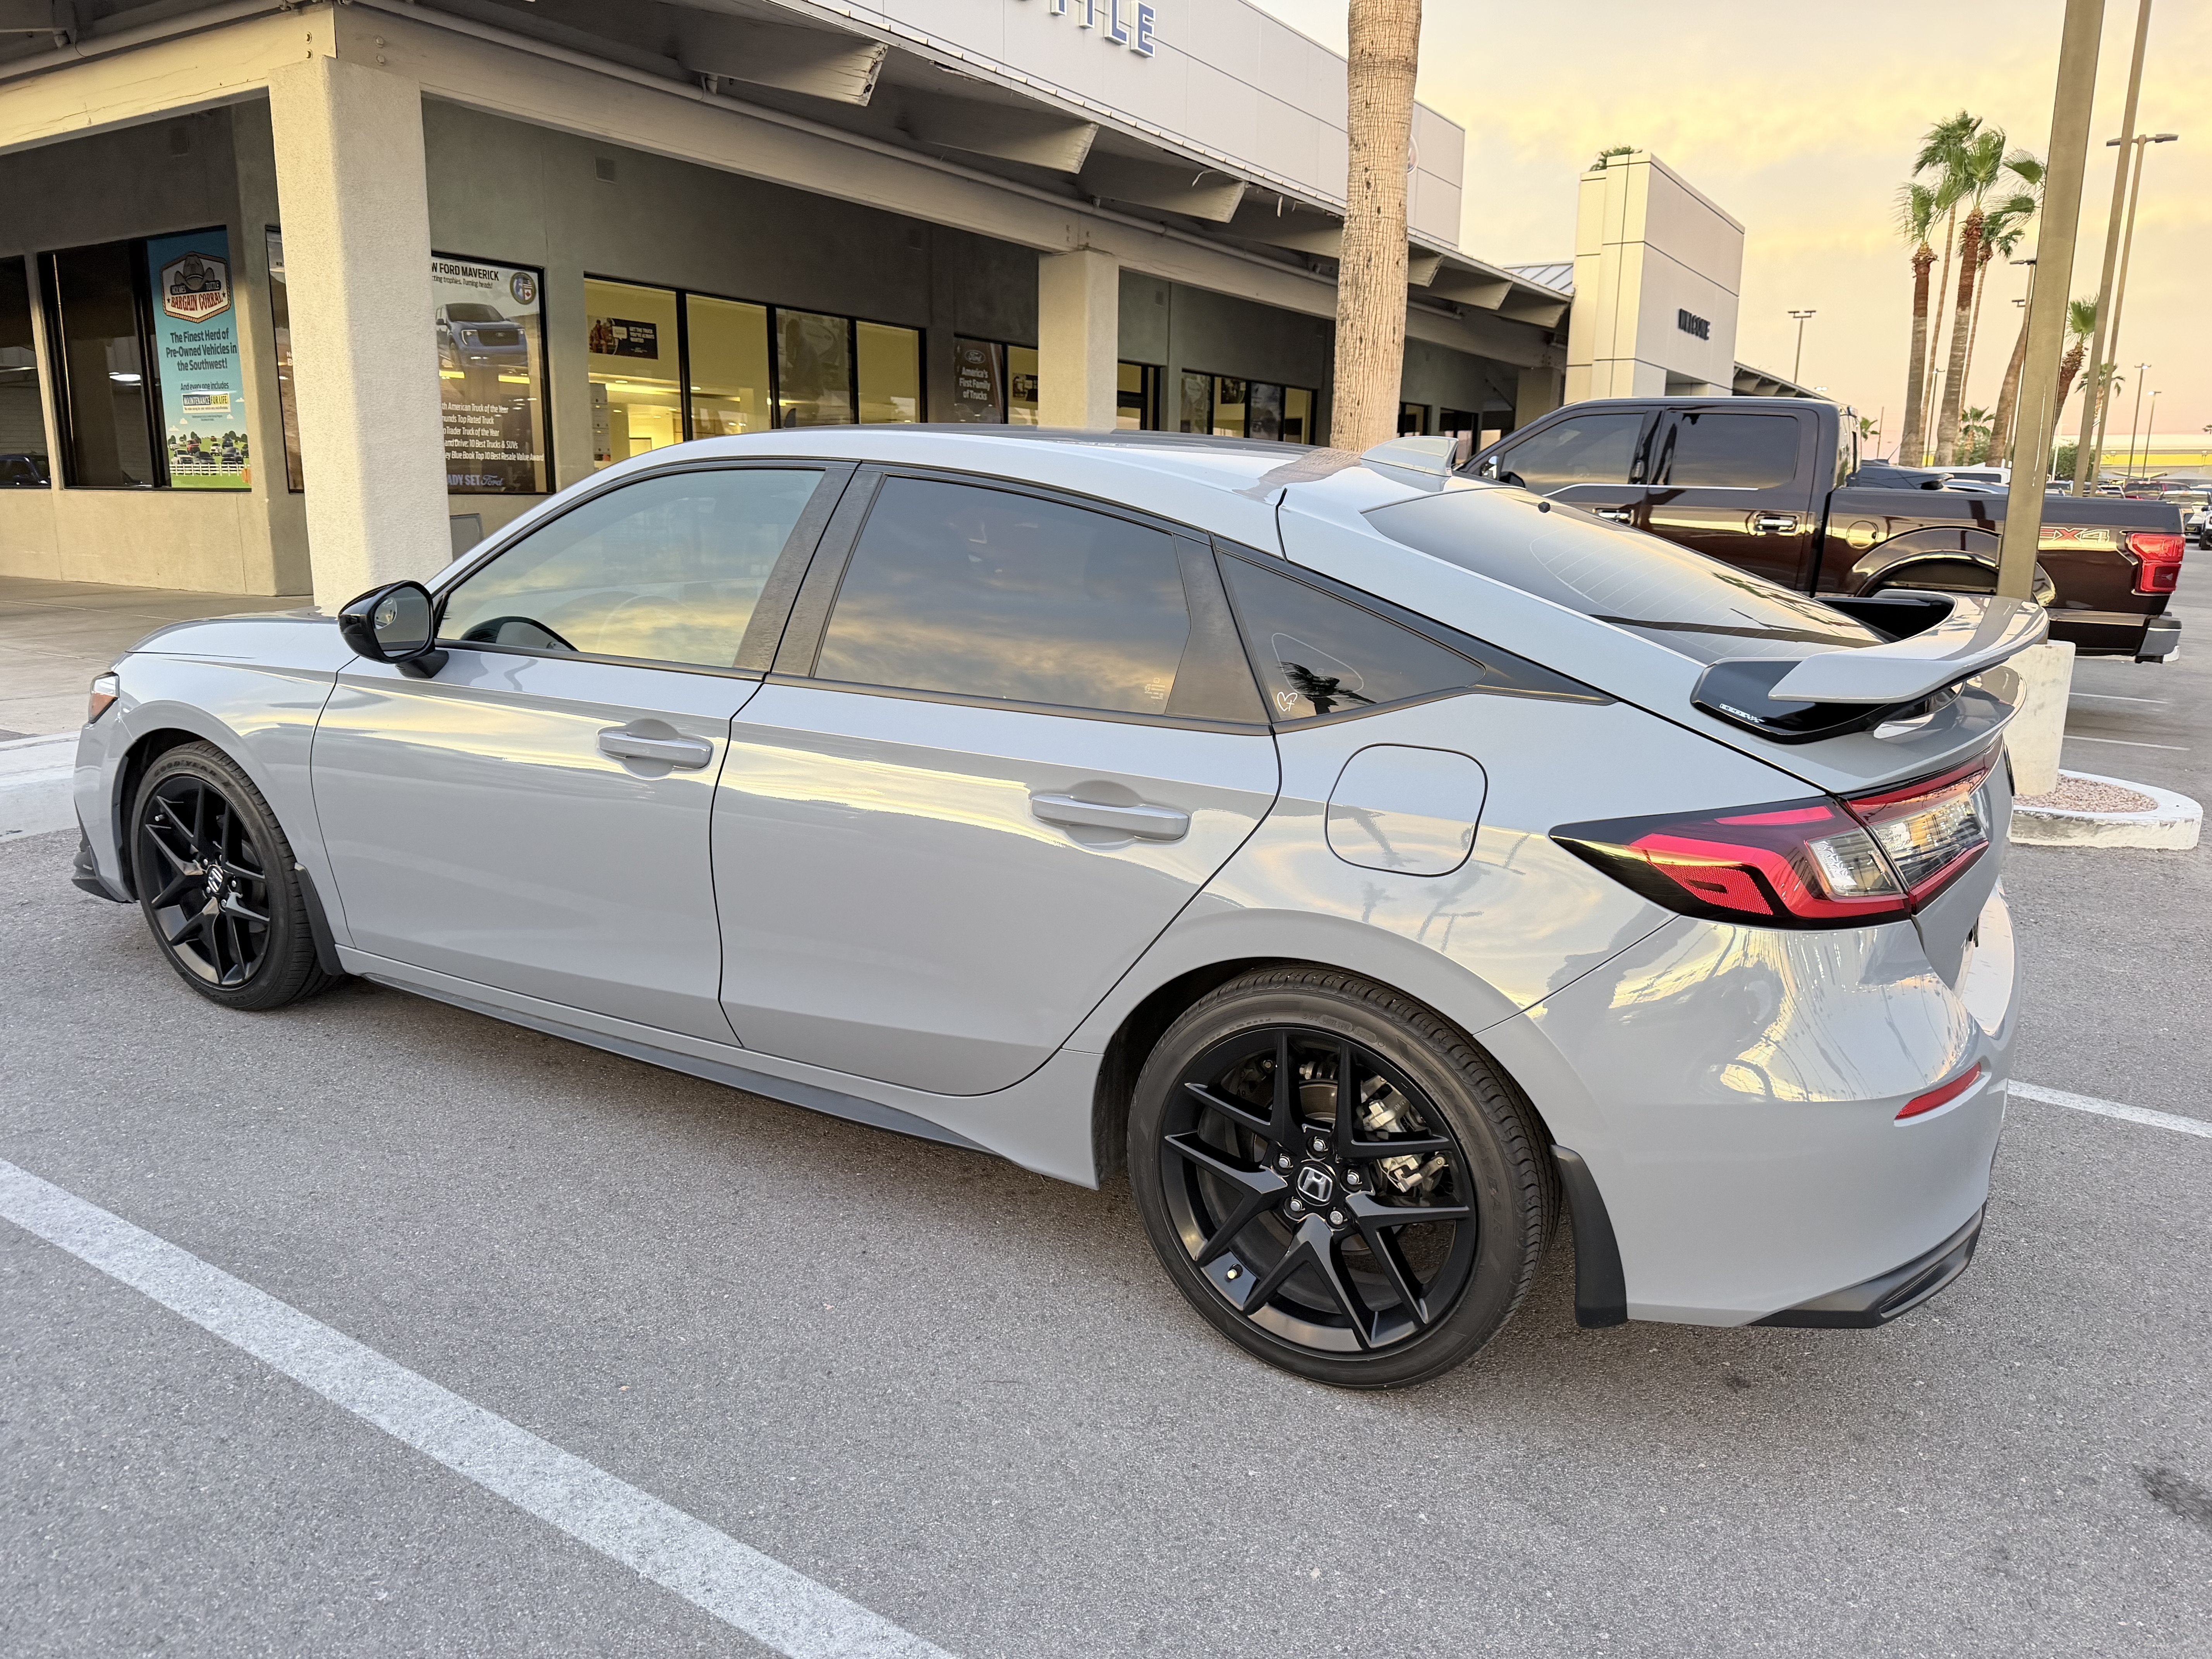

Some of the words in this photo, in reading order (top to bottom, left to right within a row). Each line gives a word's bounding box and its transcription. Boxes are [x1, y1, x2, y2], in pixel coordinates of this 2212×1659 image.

[440, 263, 460, 275] FORD
[462, 266, 499, 281] MAVERICK
[172, 285, 186, 294] HOLMES
[205, 282, 220, 290] TUTTLE
[463, 278, 478, 288] Turning
[171, 295, 198, 311] BARGAIN
[199, 292, 223, 310] CORRAL
[170, 332, 183, 343] The
[183, 331, 204, 342] Finest
[205, 328, 221, 341] Herd
[222, 328, 229, 340] of
[166, 345, 201, 358] Pre-Owned
[202, 343, 230, 356] Vehicles
[230, 342, 237, 354] in
[177, 360, 188, 371] the
[189, 358, 228, 371] Southwest!
[962, 367, 988, 378] America's
[211, 381, 229, 389] includes
[959, 378, 972, 388] First
[973, 379, 991, 391] Family
[184, 396, 210, 405] MAINTENANCE
[219, 396, 227, 404] LIFE
[963, 390, 970, 398] of
[970, 390, 987, 400] Trucks
[448, 402, 471, 411] American
[471, 404, 484, 412] Truck
[484, 404, 490, 414] of
[490, 405, 498, 413] the
[498, 405, 509, 413] Year
[457, 415, 467, 424] Top
[467, 415, 481, 424] Rated
[481, 416, 494, 424] Truck
[462, 427, 474, 435] Truck
[475, 428, 481, 437] of
[481, 428, 489, 436] the
[489, 428, 500, 436] Year
[445, 438, 454, 447] and
[469, 439, 475, 447] 10
[476, 440, 486, 448] Best
[486, 440, 501, 448] Trucks
[501, 440, 505, 448] &
[506, 441, 518, 449] SUVs
[451, 450, 462, 459] Blue
[462, 451, 475, 459] Book
[475, 452, 484, 461] Top
[484, 452, 490, 460] 10
[490, 452, 501, 460] Best
[501, 452, 516, 460] Resale
[516, 453, 529, 461] Value
[529, 453, 544, 461] Award
[464, 474, 480, 486] SET
[480, 474, 503, 486] Ford
